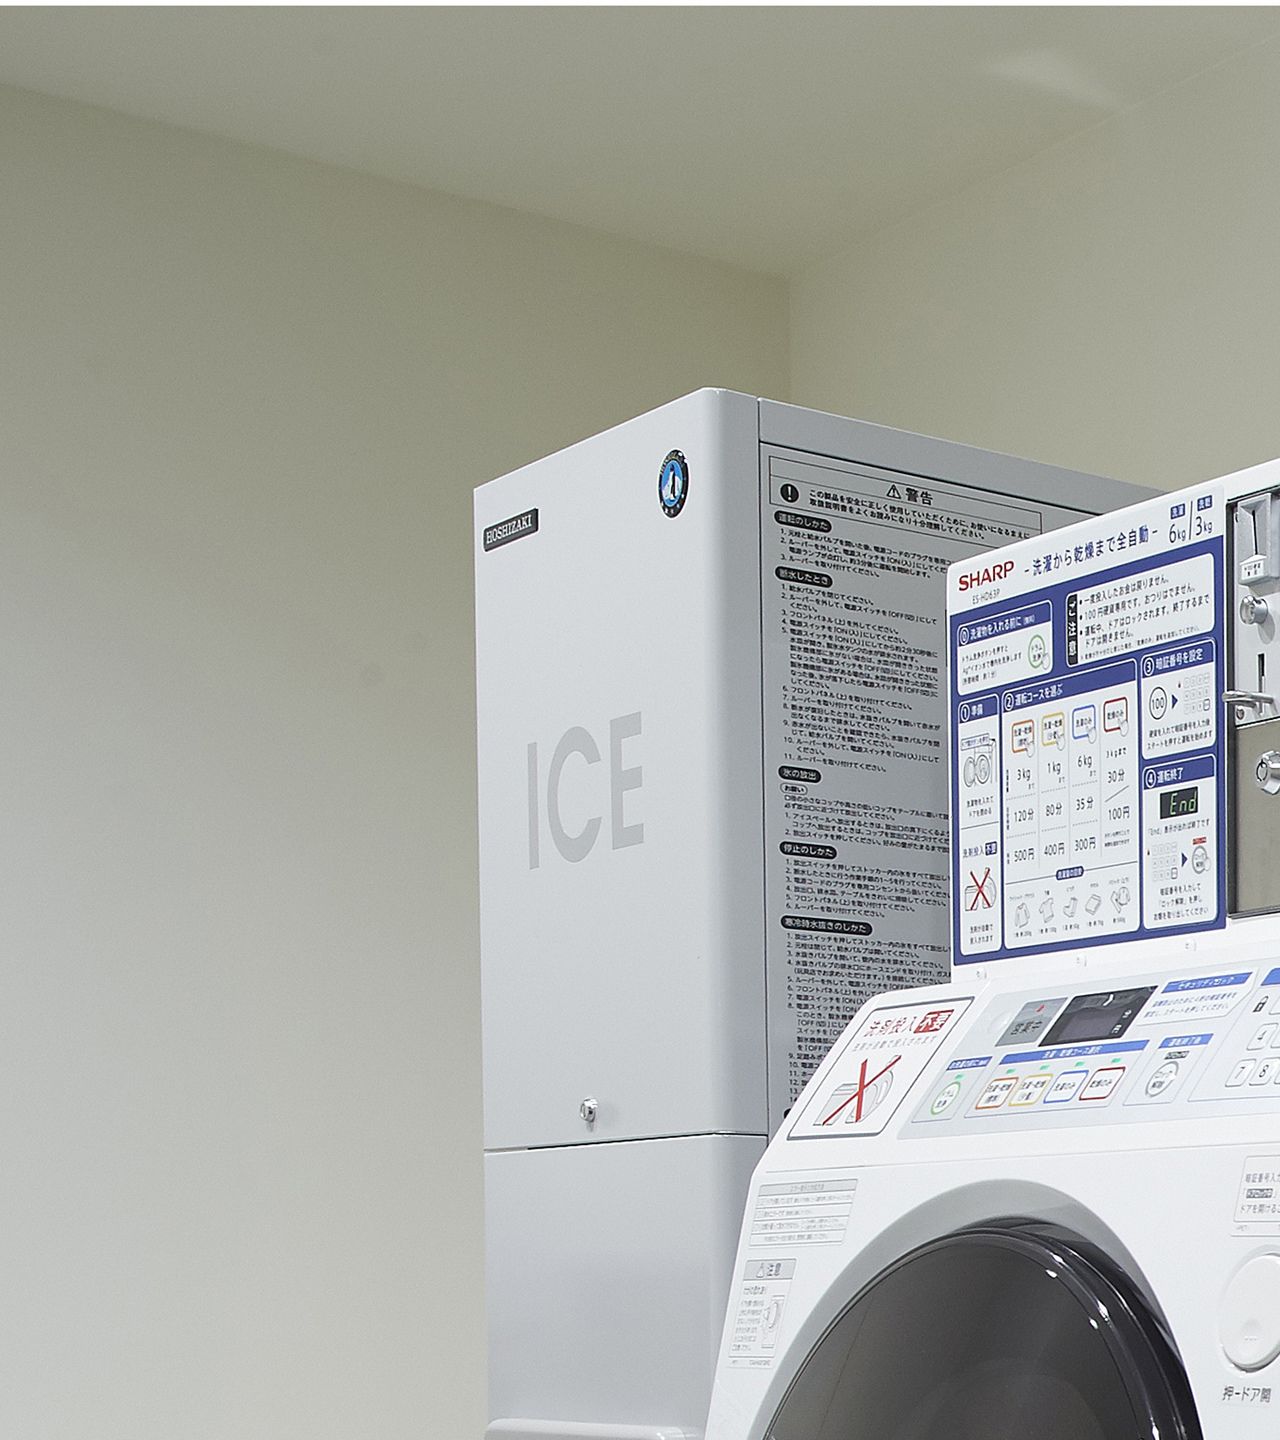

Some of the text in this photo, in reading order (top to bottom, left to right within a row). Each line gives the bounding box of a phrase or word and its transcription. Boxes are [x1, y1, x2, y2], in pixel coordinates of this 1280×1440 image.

[905, 487, 933, 506] 警告
[485, 515, 533, 544] HOSHIZAKI
[958, 560, 1014, 592] SHARP
[528, 711, 644, 869] ICE
[1170, 792, 1198, 813] End
